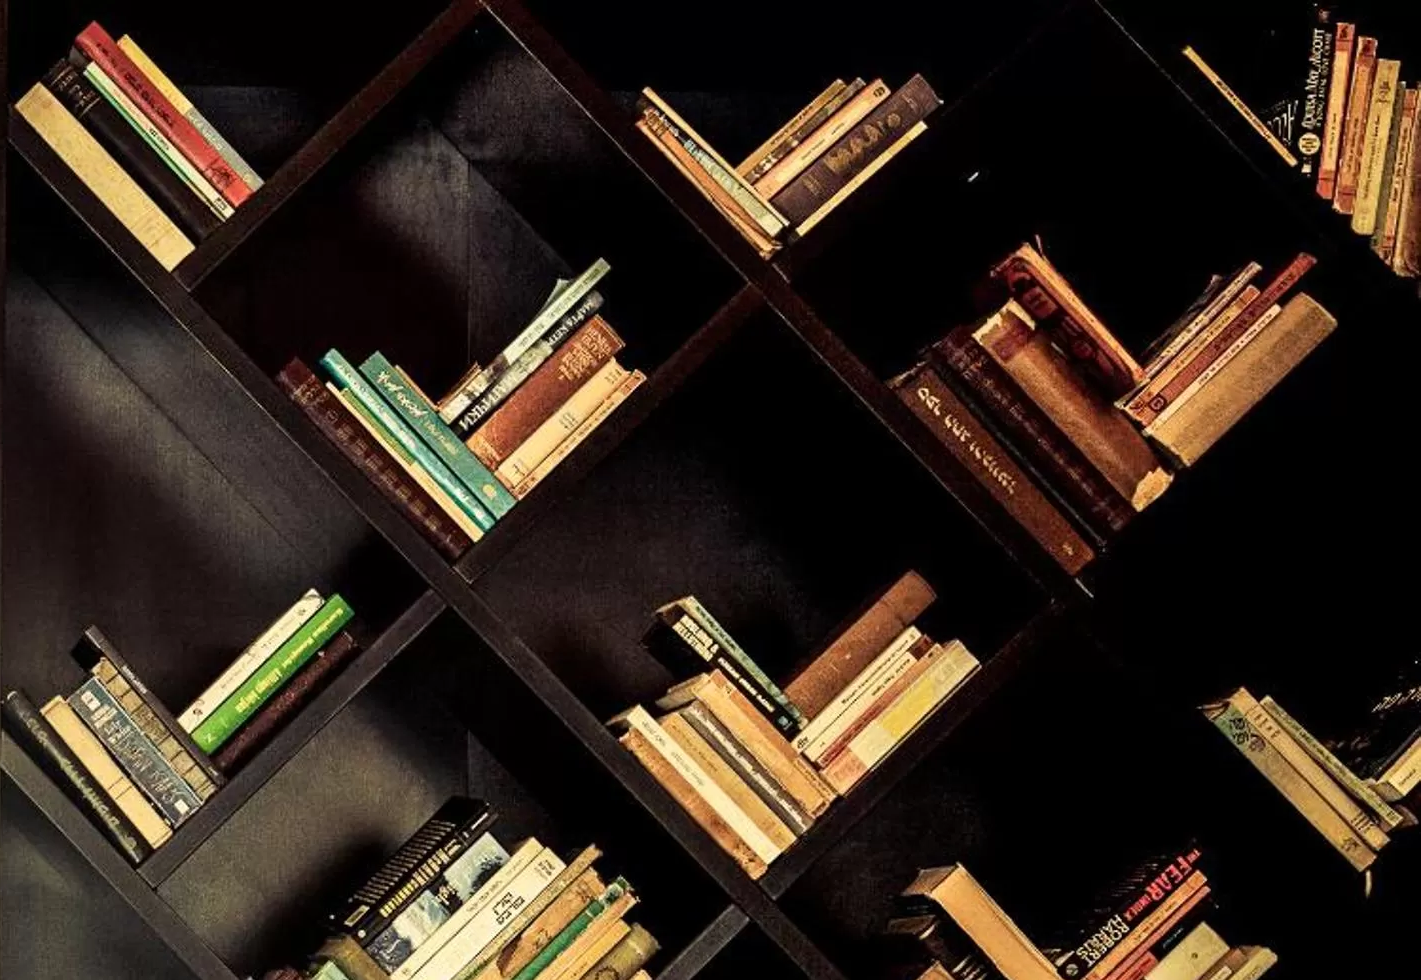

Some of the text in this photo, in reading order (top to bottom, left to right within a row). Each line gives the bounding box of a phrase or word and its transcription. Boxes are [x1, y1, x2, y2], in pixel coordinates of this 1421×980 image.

[1300, 93, 1318, 129] LOUISA
[914, 384, 947, 416] ספר
[1143, 854, 1192, 903] FEAR
[1073, 913, 1122, 960] HARRIS
[1081, 920, 1130, 968] ROBERT
